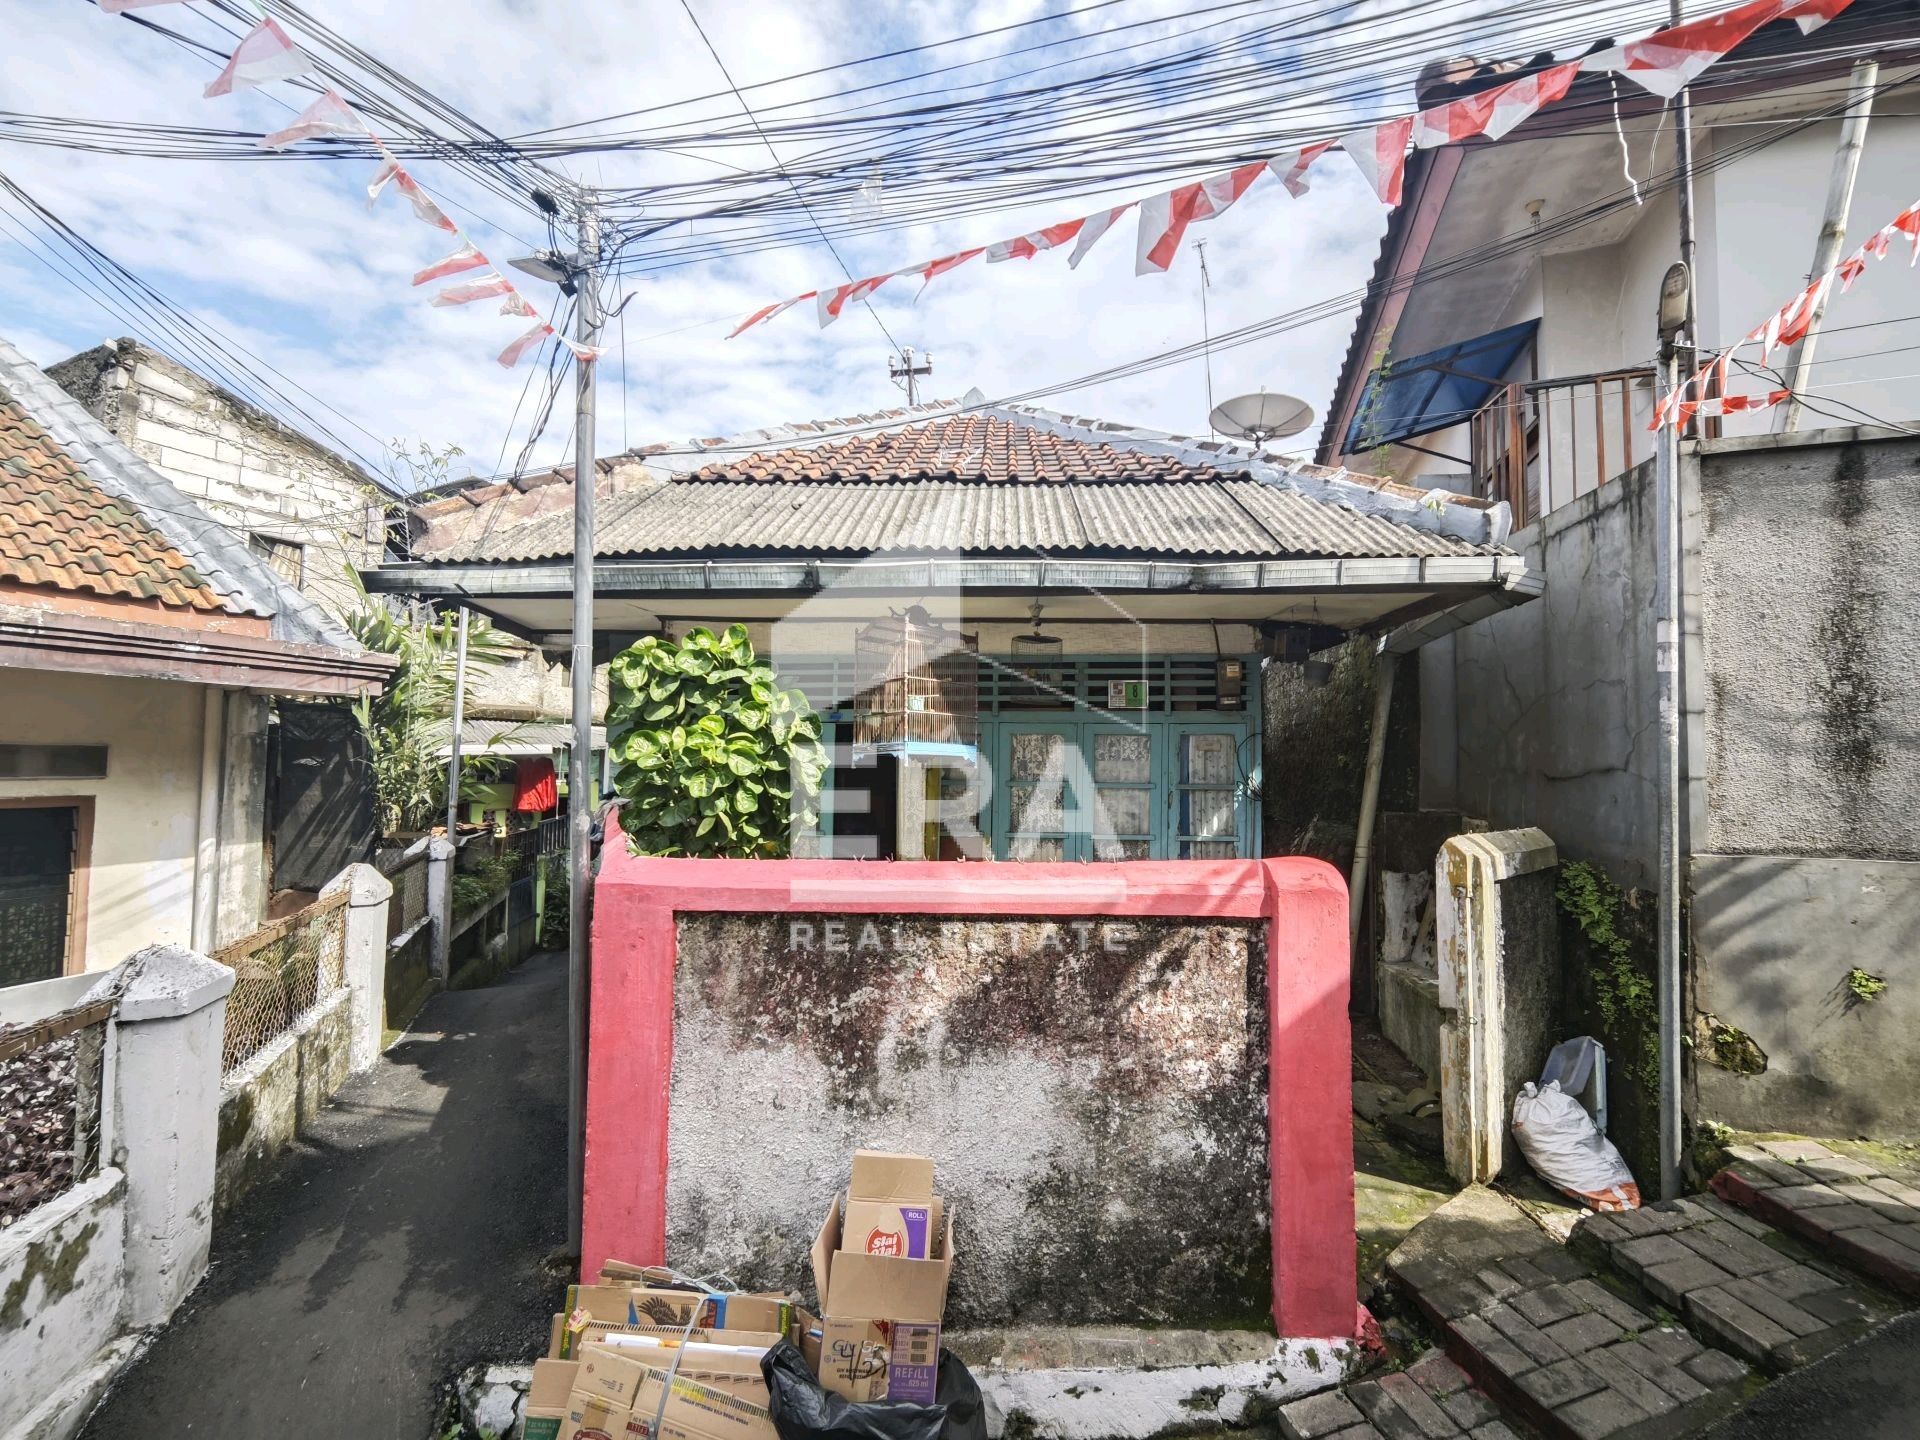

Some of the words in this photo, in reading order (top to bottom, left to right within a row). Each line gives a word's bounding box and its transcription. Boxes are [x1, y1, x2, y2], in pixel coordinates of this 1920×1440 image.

[1132, 684, 1138, 698] 8
[908, 1211, 924, 1219] ROLL
[895, 1367, 929, 1379] REFILL
